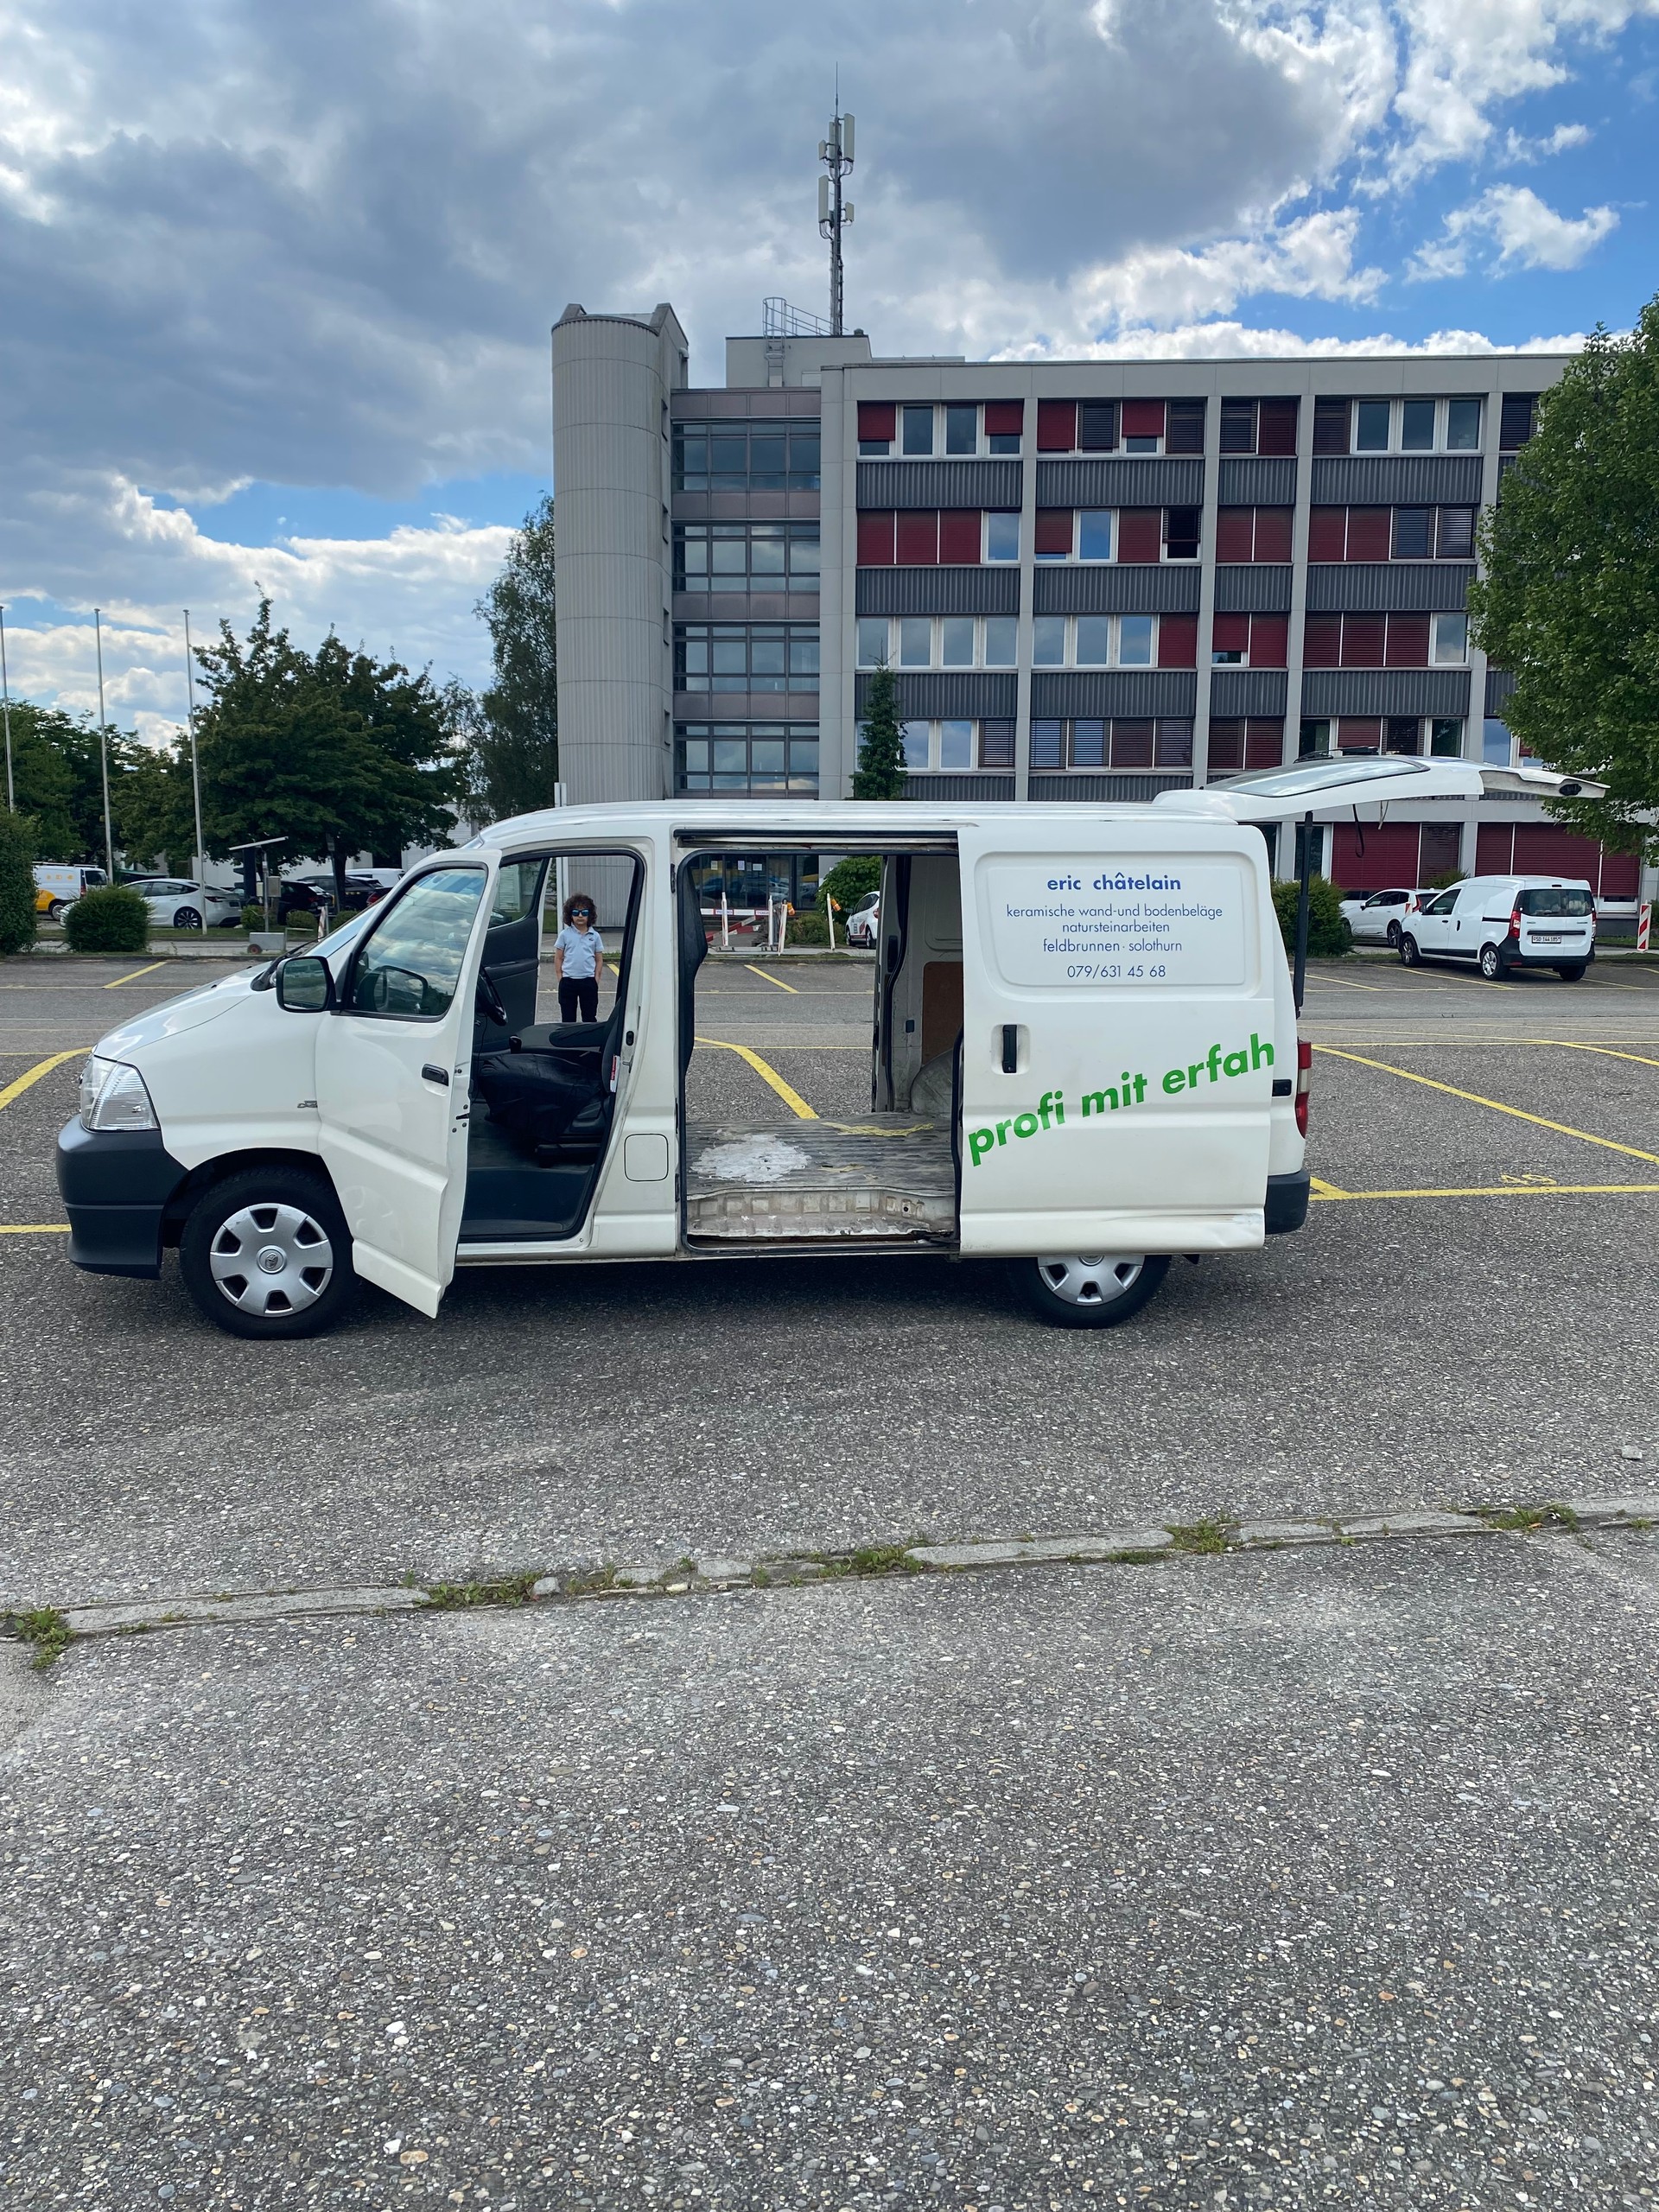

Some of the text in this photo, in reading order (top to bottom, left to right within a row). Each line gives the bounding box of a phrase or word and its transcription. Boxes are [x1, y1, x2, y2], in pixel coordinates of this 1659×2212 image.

[1047, 872, 1182, 891] eric châtelain
[1007, 903, 1075, 918] keramische
[1144, 904, 1223, 920] bodenbeläge
[1062, 919, 1170, 933] natursteinarbeiten
[1043, 938, 1182, 952] feldbrunnen solothurn
[1067, 964, 1166, 980] 079/631 45 68
[968, 1033, 1274, 1166] profi mit erfah
